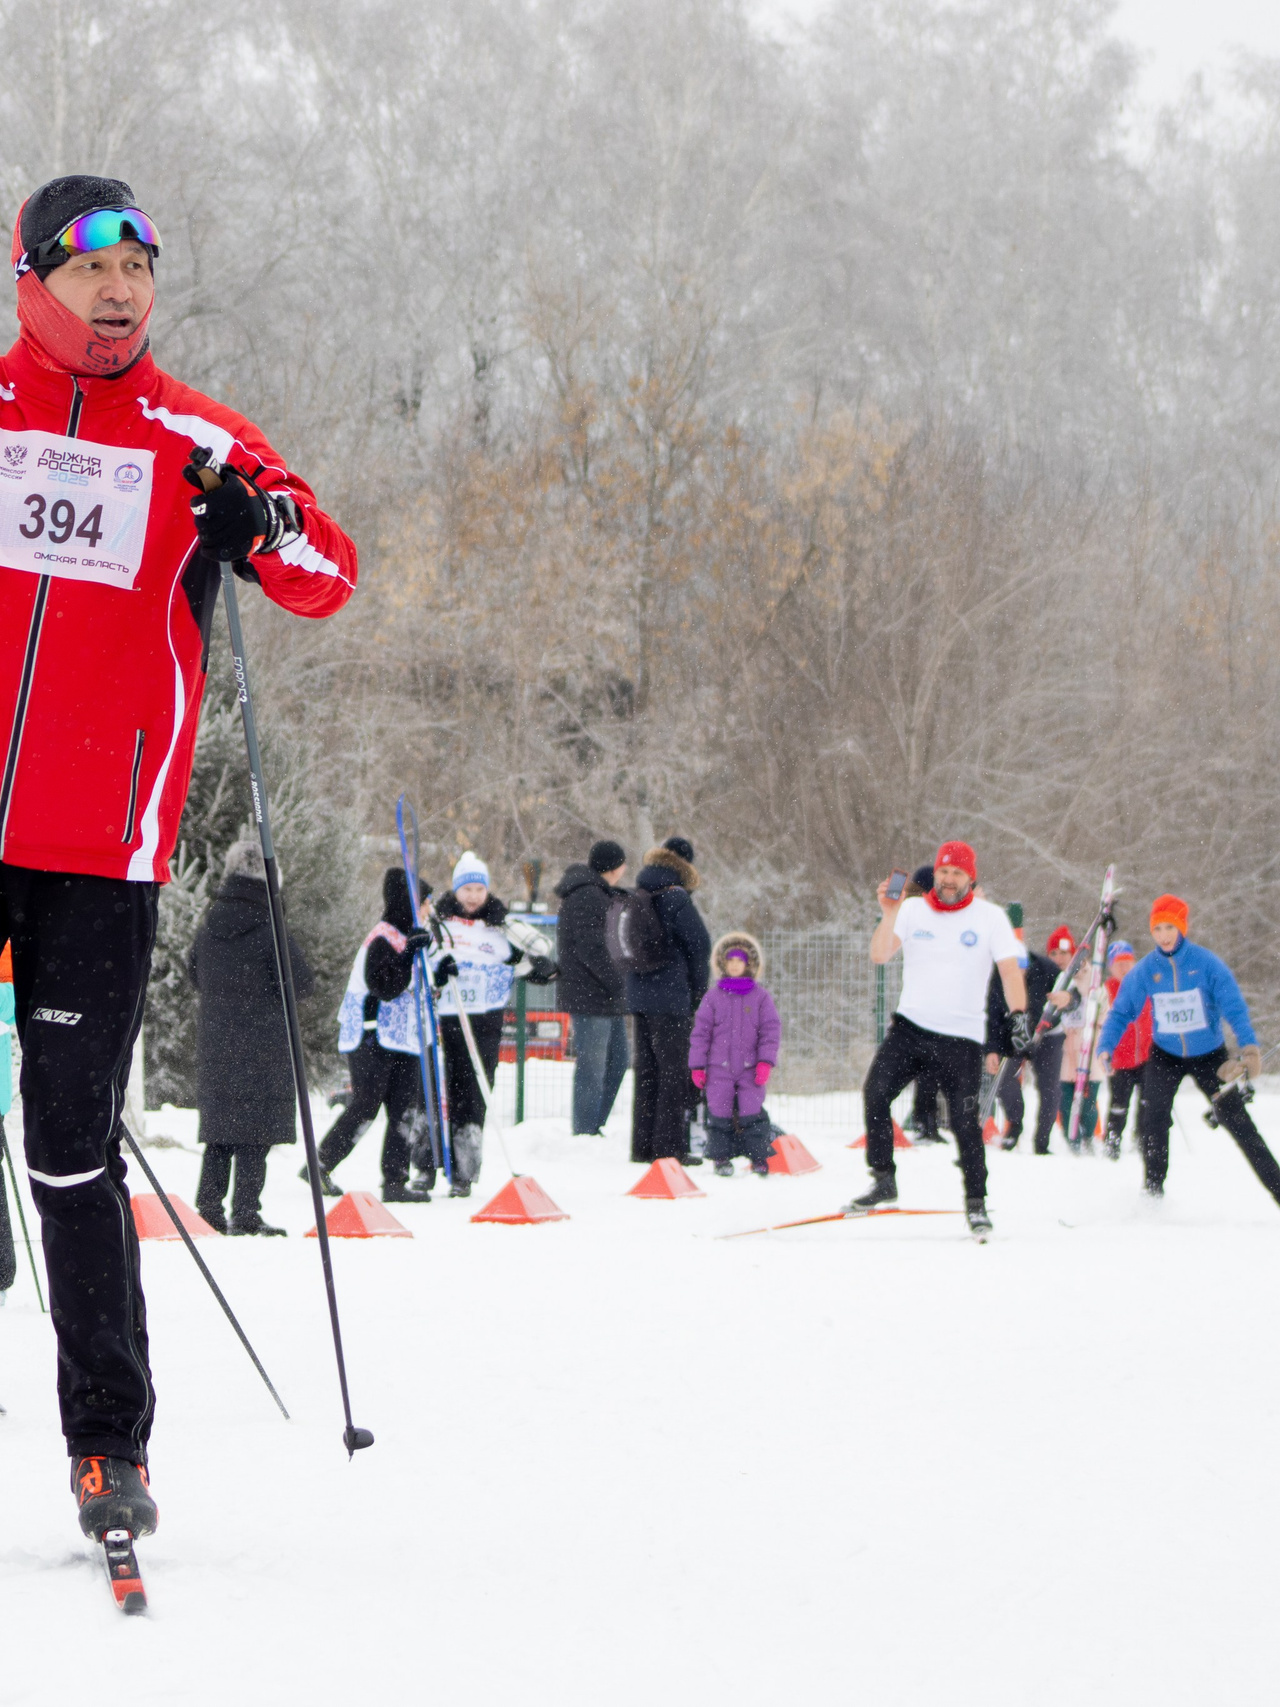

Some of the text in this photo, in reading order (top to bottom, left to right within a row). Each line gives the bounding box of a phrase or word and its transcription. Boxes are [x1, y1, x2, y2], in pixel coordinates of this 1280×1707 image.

[37, 458, 103, 478] РОССИИ
[41, 448, 102, 468] ЛЫЖНЯ
[47, 471, 89, 486] 2025
[19, 493, 103, 548] 394
[34, 552, 130, 574] ОМСКАЯ ОБЛАСТЬ
[445, 989, 476, 1003] 193
[32, 1007, 82, 1026] KV+
